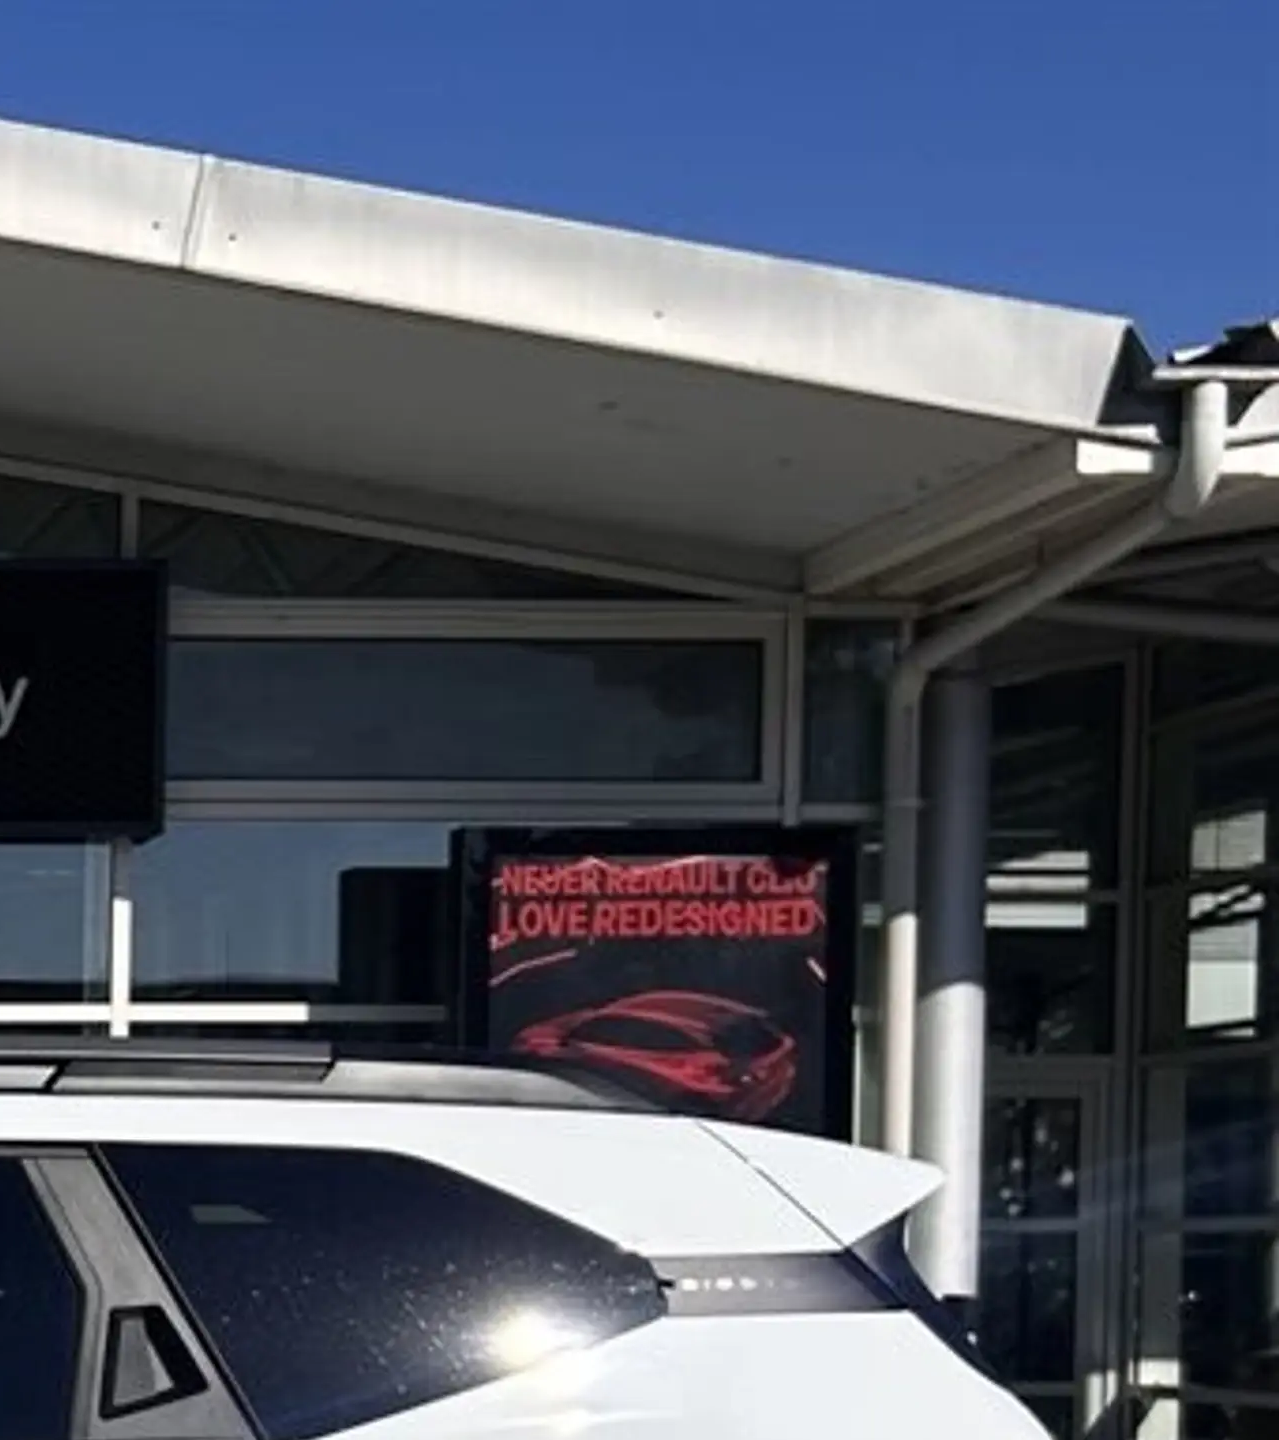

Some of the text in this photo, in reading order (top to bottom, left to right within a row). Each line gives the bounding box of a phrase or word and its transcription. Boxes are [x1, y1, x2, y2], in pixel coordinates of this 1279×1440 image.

[603, 862, 742, 895] RENAULT
[498, 900, 816, 939] LOVE REDESIGNED
